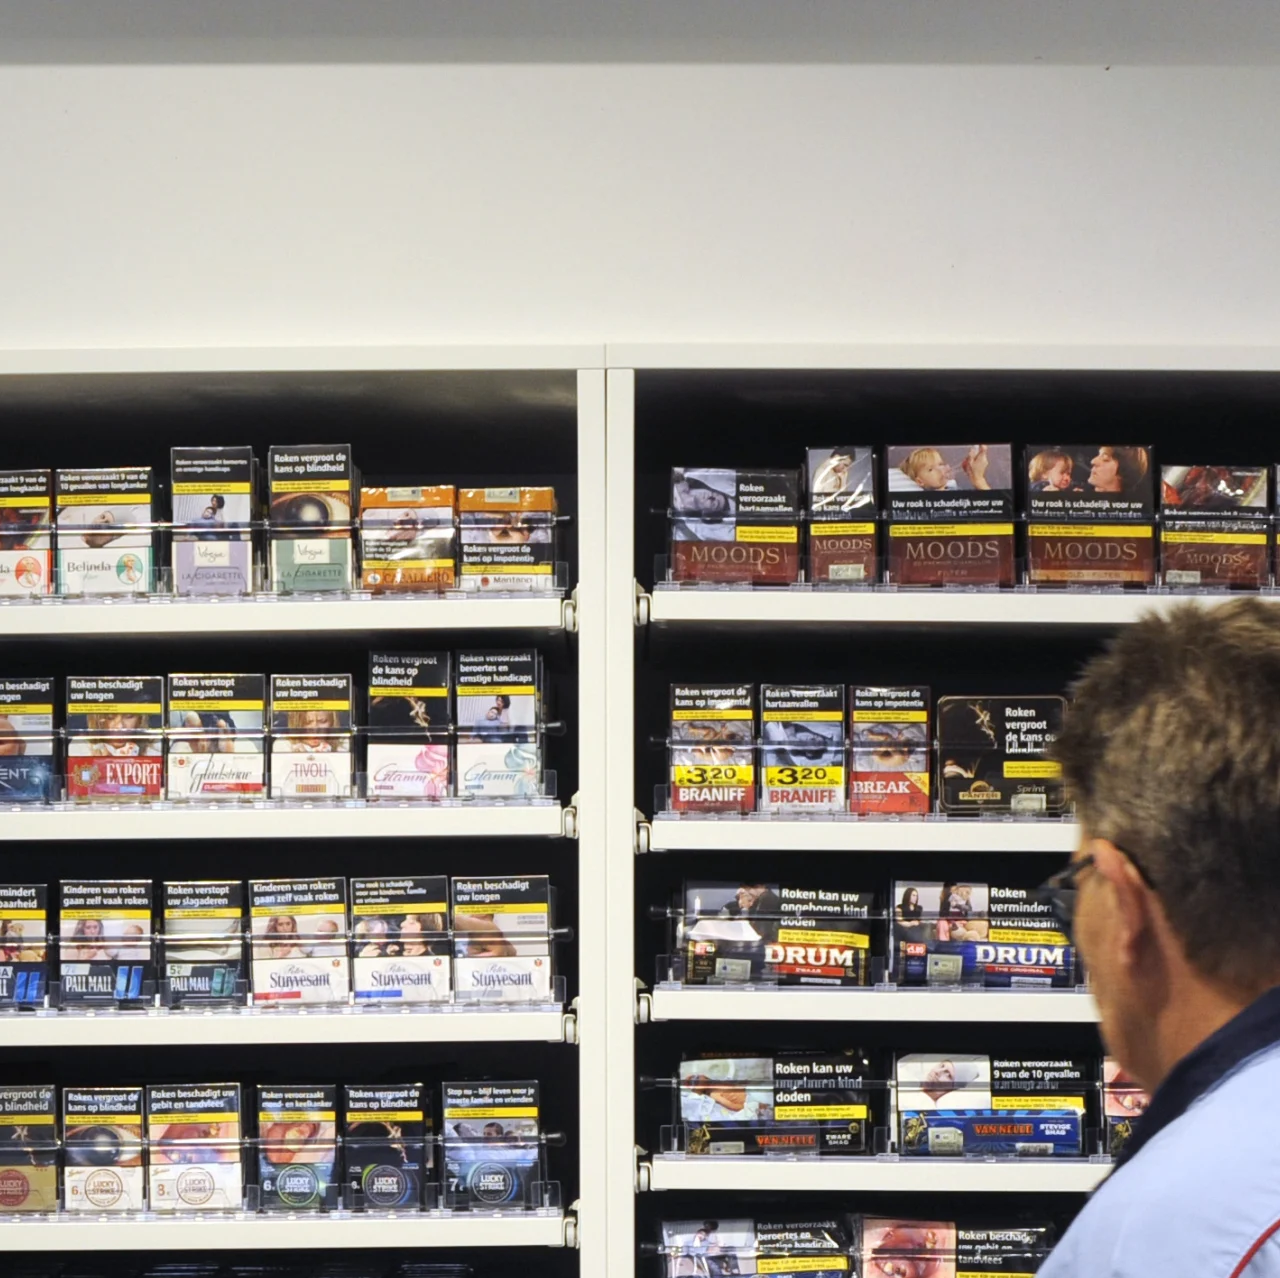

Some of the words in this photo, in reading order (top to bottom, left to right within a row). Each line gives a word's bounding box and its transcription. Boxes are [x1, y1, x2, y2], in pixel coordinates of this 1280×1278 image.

[691, 546, 780, 564] MOODS
[906, 540, 1000, 559] MOODS
[1044, 542, 1138, 560] MOODS
[1005, 707, 1036, 718] Roken
[1005, 720, 1048, 732] vergroot
[1005, 733, 1018, 742] de
[1020, 733, 1043, 742] kans
[853, 781, 911, 794] BREAK
[1017, 784, 1046, 794] Sprint
[679, 787, 746, 803] BRANIFF
[770, 789, 837, 804] BRANIFF
[254, 883, 292, 894] Kinderen
[294, 882, 308, 892] van
[310, 881, 336, 892] rokers
[764, 945, 854, 967] DRUM
[976, 945, 1064, 966] DRUM
[775, 1063, 807, 1075] Roken
[809, 1063, 834, 1075] kan
[836, 1063, 853, 1074] uw
[775, 1090, 811, 1103] doden
